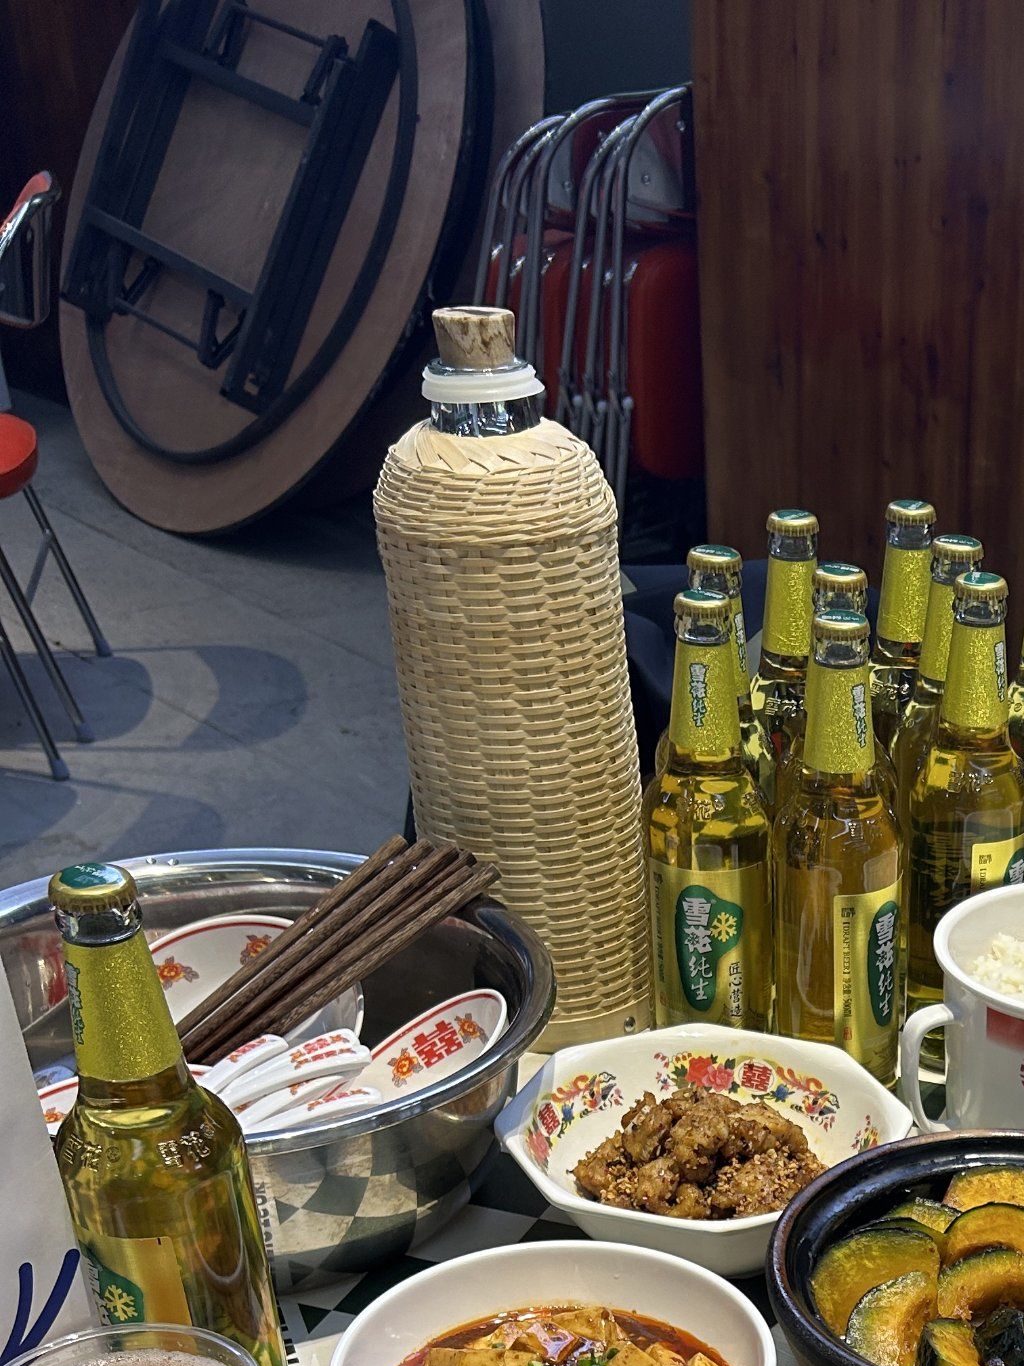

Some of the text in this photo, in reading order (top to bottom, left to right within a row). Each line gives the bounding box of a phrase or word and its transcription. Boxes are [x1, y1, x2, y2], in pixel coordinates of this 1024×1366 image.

[682, 897, 713, 1001] 雪花纯生
[729, 962, 743, 1018] 匠心营造
[875, 911, 897, 1017] 雪花纯生
